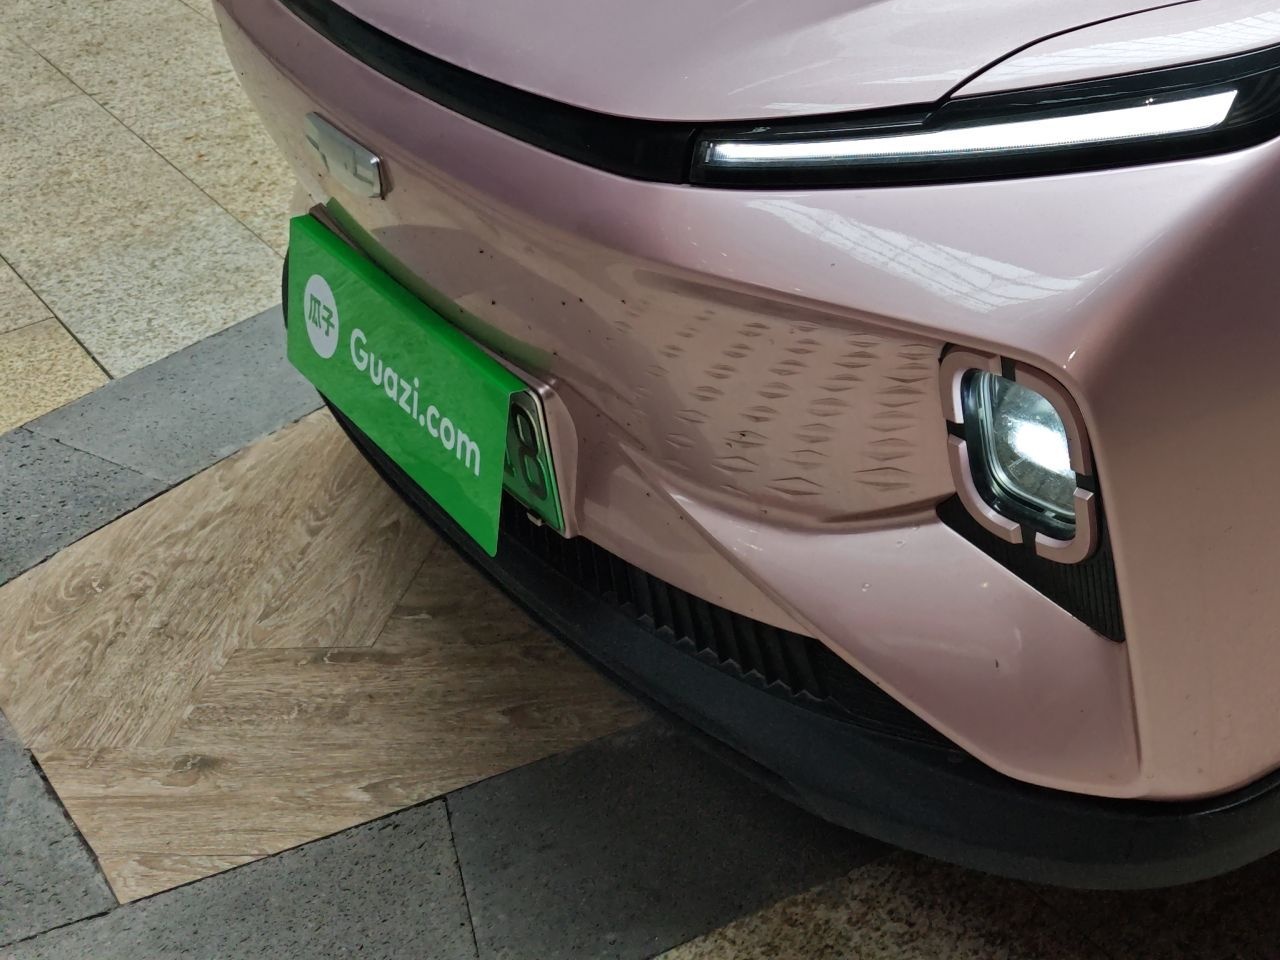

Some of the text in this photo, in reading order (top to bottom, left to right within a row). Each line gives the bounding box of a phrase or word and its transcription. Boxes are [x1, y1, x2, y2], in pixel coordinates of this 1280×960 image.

[309, 293, 335, 337] 瓜子
[350, 328, 481, 477] Guazi.com
[505, 402, 548, 501] 8
